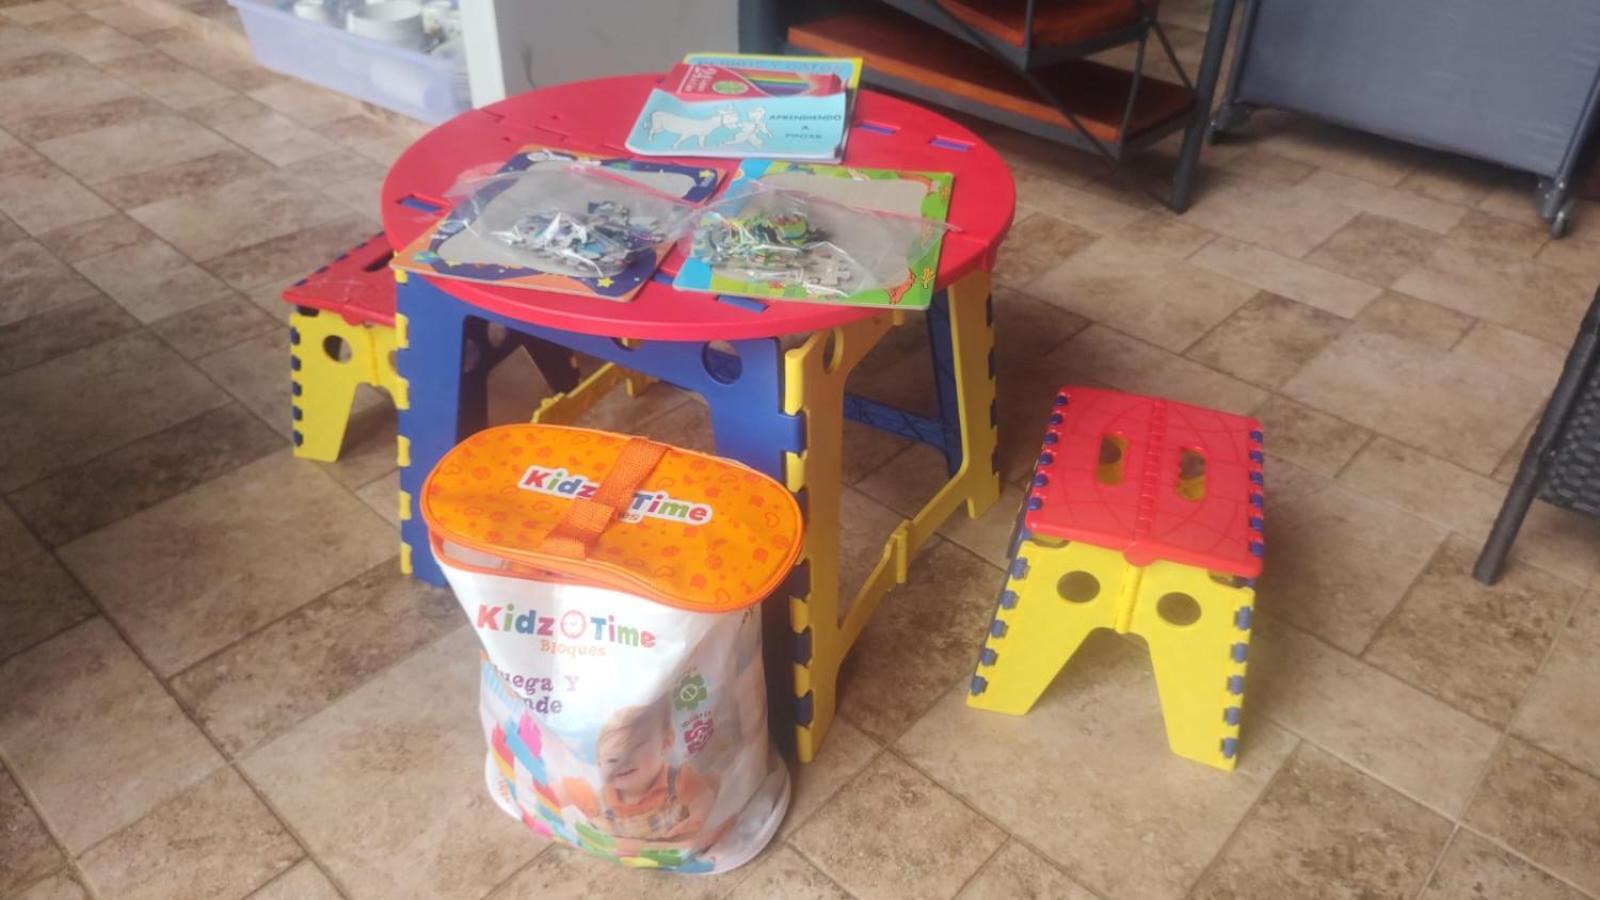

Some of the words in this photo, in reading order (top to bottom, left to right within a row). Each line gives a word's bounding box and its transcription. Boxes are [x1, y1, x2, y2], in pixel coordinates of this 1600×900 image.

[524, 468, 600, 499] Kidz
[631, 492, 708, 522] Time
[476, 603, 555, 637] Kidz
[590, 615, 657, 648] Time
[539, 639, 607, 658] Bloques
